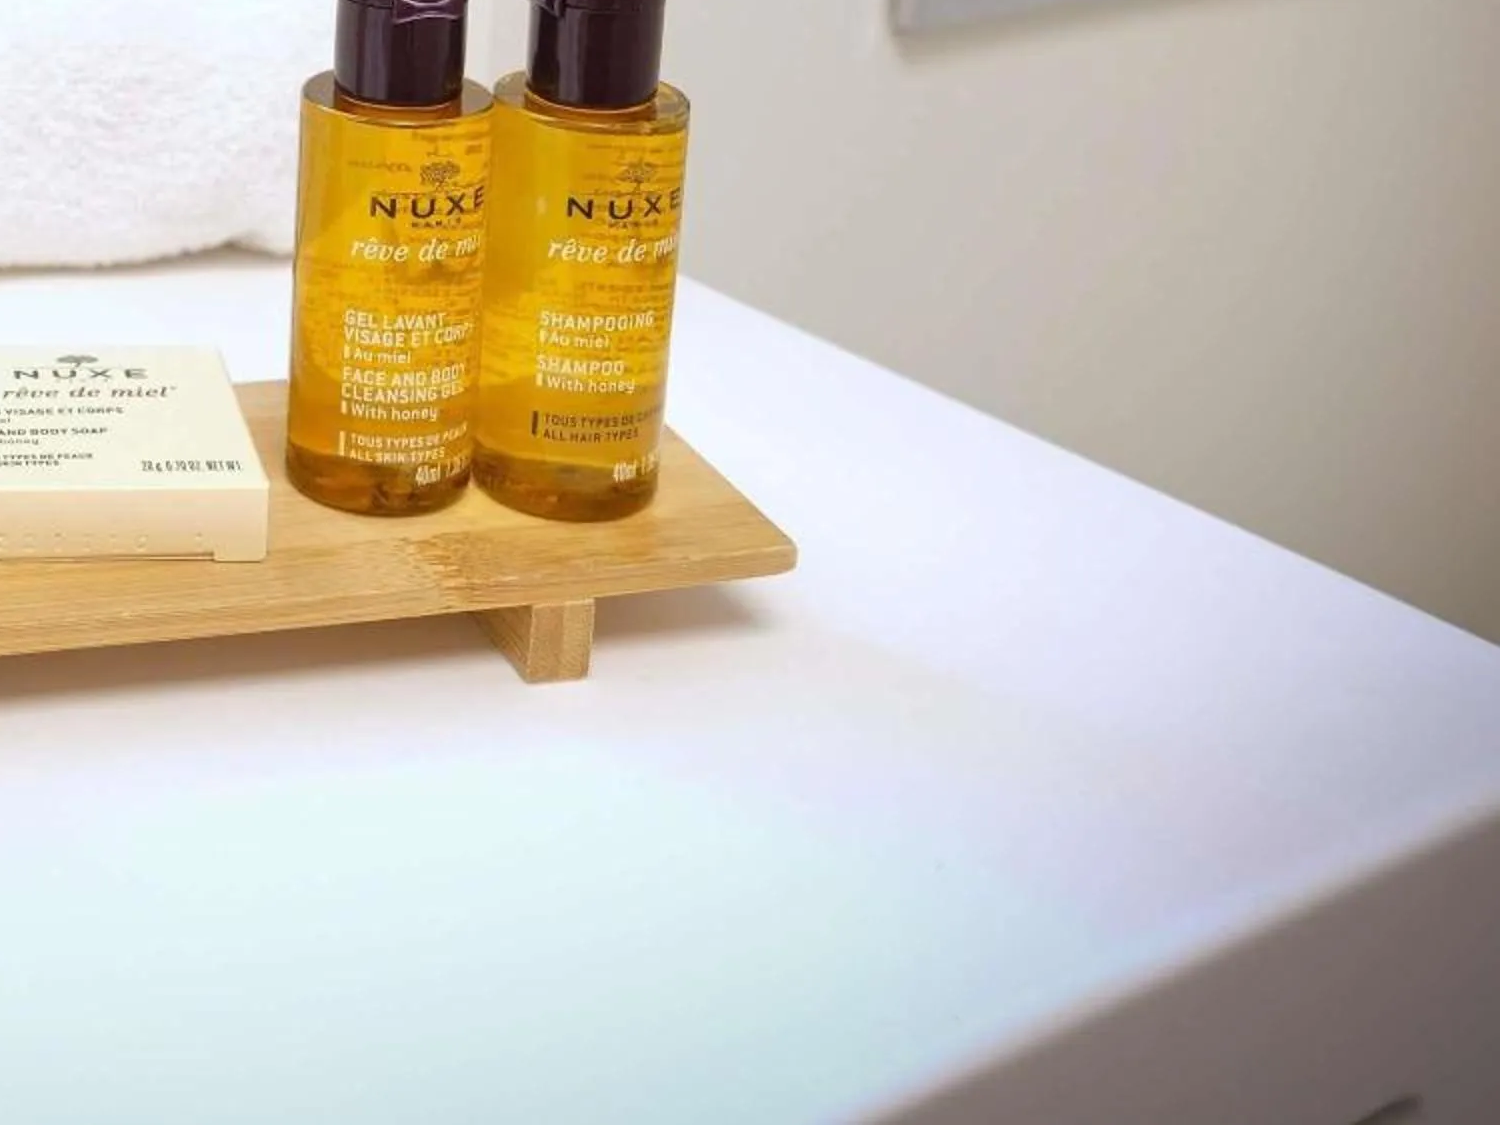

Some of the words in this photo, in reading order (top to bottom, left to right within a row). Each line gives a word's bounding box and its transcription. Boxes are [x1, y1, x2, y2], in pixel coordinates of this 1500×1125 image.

[370, 185, 485, 219] NUXE
[566, 187, 681, 219] NUXE
[351, 237, 409, 262] rêve
[418, 238, 448, 262] de
[548, 238, 609, 263] rêve
[618, 238, 647, 263] de
[344, 310, 377, 327] GEL
[384, 313, 447, 330] LAVANT
[540, 309, 655, 332] SHAMPOOING
[344, 326, 405, 347] VISAGE
[411, 331, 430, 347] ET
[550, 331, 569, 346] Au
[575, 335, 610, 348] miel
[354, 347, 372, 361] Au
[378, 350, 411, 364] miel
[537, 354, 625, 376] SHAMPOO
[14, 368, 148, 380] NUXE
[343, 366, 385, 386] FACE
[392, 372, 427, 387] AND
[3, 387, 59, 399] rêve
[69, 386, 101, 398] de
[111, 386, 169, 398] miel
[341, 382, 437, 404] CLEANSING
[547, 377, 583, 392] With
[588, 379, 636, 394] honey
[351, 400, 387, 419] With
[391, 406, 437, 422] honey
[545, 414, 577, 427] TOUS
[581, 416, 618, 427] TYPES
[72, 427, 108, 435] SOAP
[351, 433, 383, 448] TOUS
[386, 436, 423, 448] TYPES
[543, 428, 567, 441] ALL
[570, 433, 600, 443] HAIR
[606, 427, 639, 441] TYPES
[350, 448, 373, 461] ALL
[376, 452, 406, 464] SKIN
[410, 447, 445, 464] TYPES
